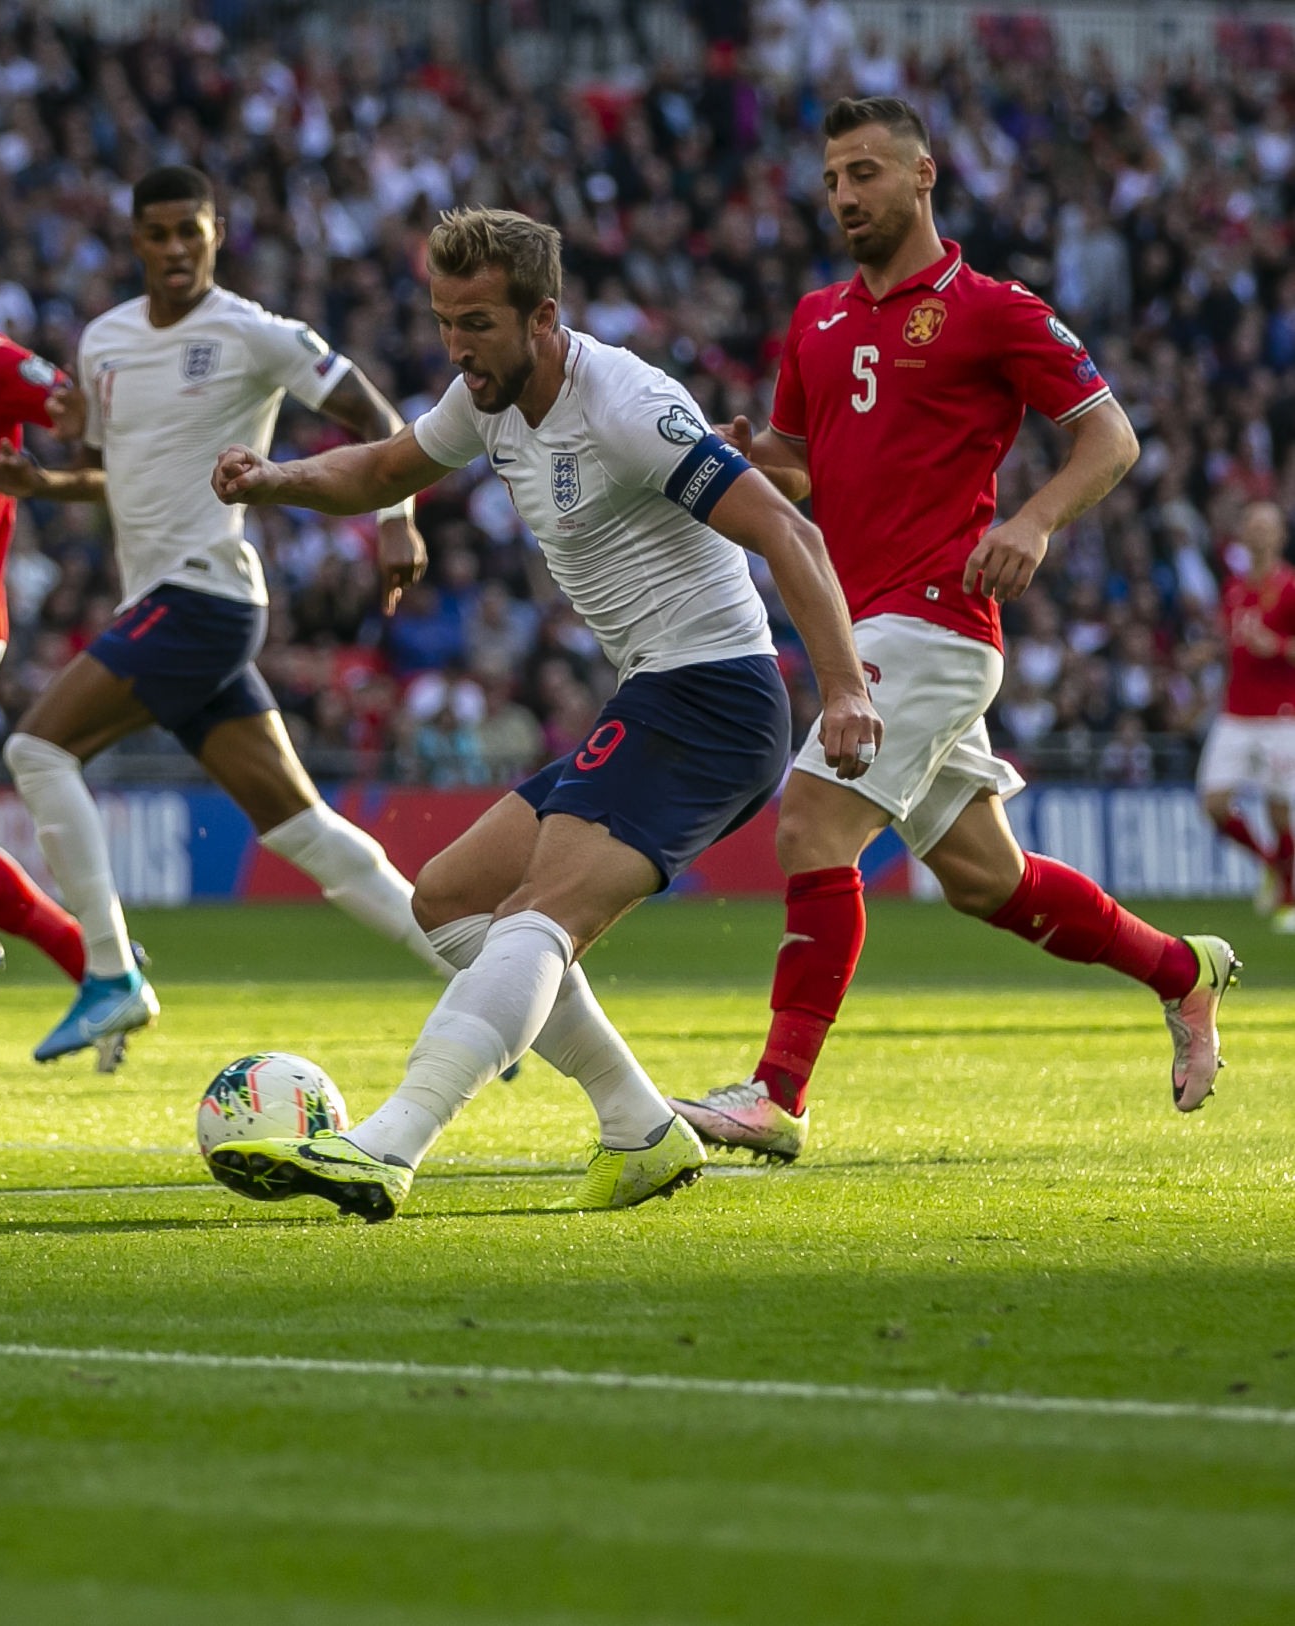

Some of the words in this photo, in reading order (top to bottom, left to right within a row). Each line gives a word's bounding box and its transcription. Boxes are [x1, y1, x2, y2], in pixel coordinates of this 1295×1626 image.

[851, 344, 880, 414] 5
[682, 457, 720, 507] RESPECT
[575, 719, 626, 771] 9
